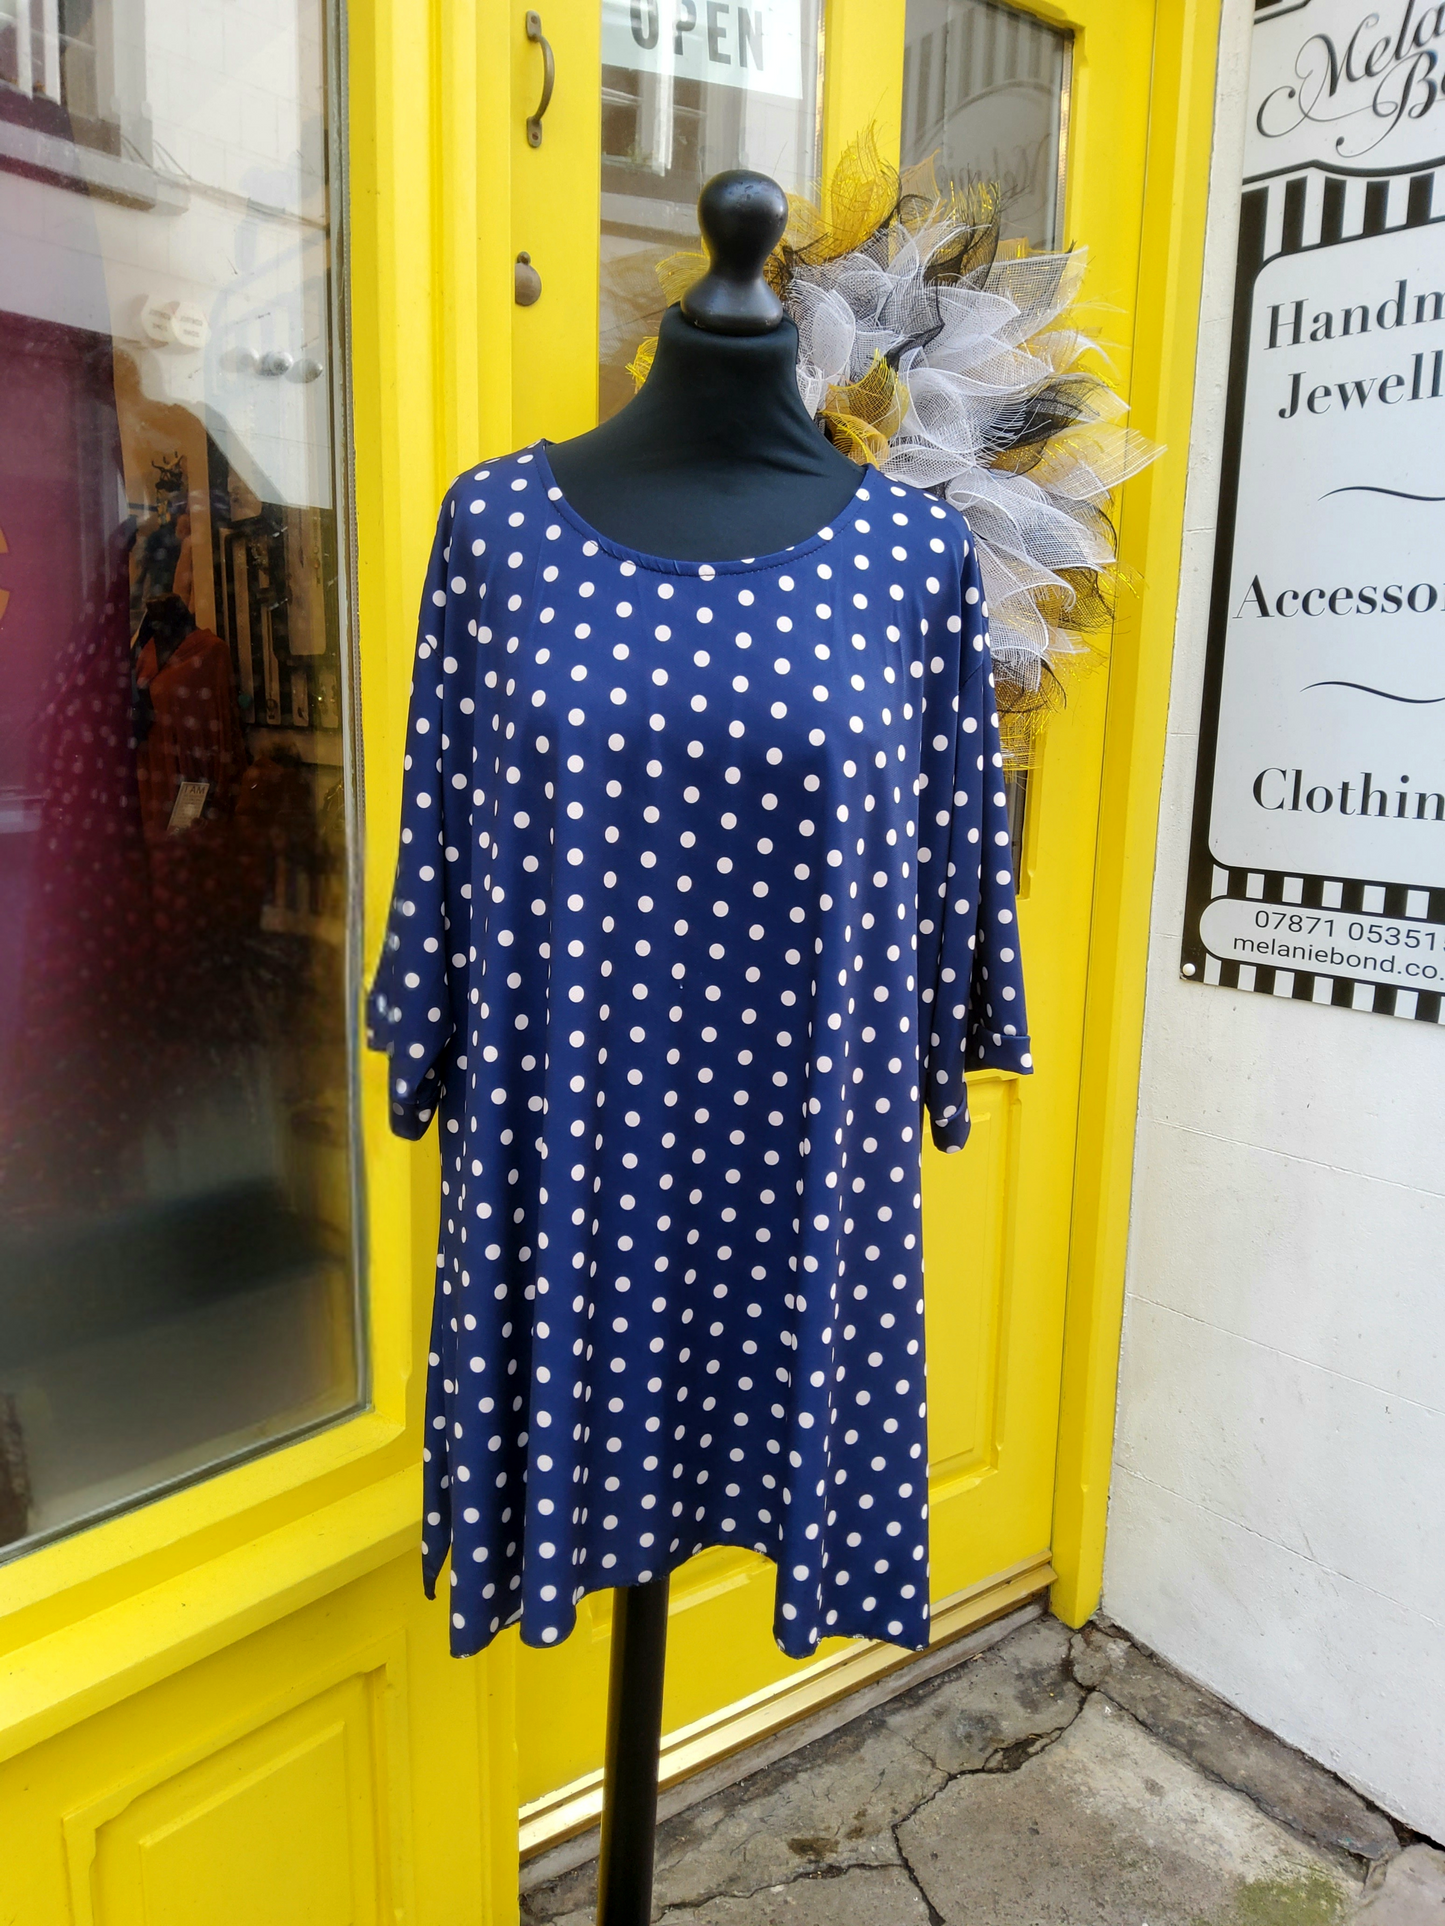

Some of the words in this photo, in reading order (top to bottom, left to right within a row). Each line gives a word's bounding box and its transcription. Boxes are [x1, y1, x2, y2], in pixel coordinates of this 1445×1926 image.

[630, 0, 764, 71] OPEN
[1335, 49, 1445, 158] B
[1278, 349, 1444, 419] Jewell
[1232, 574, 1445, 619] Accesso
[1252, 767, 1445, 822] Clothin
[1255, 910, 1335, 938] 07871
[1348, 922, 1445, 951] 05351
[1233, 937, 1445, 981] melaniebond.co.
